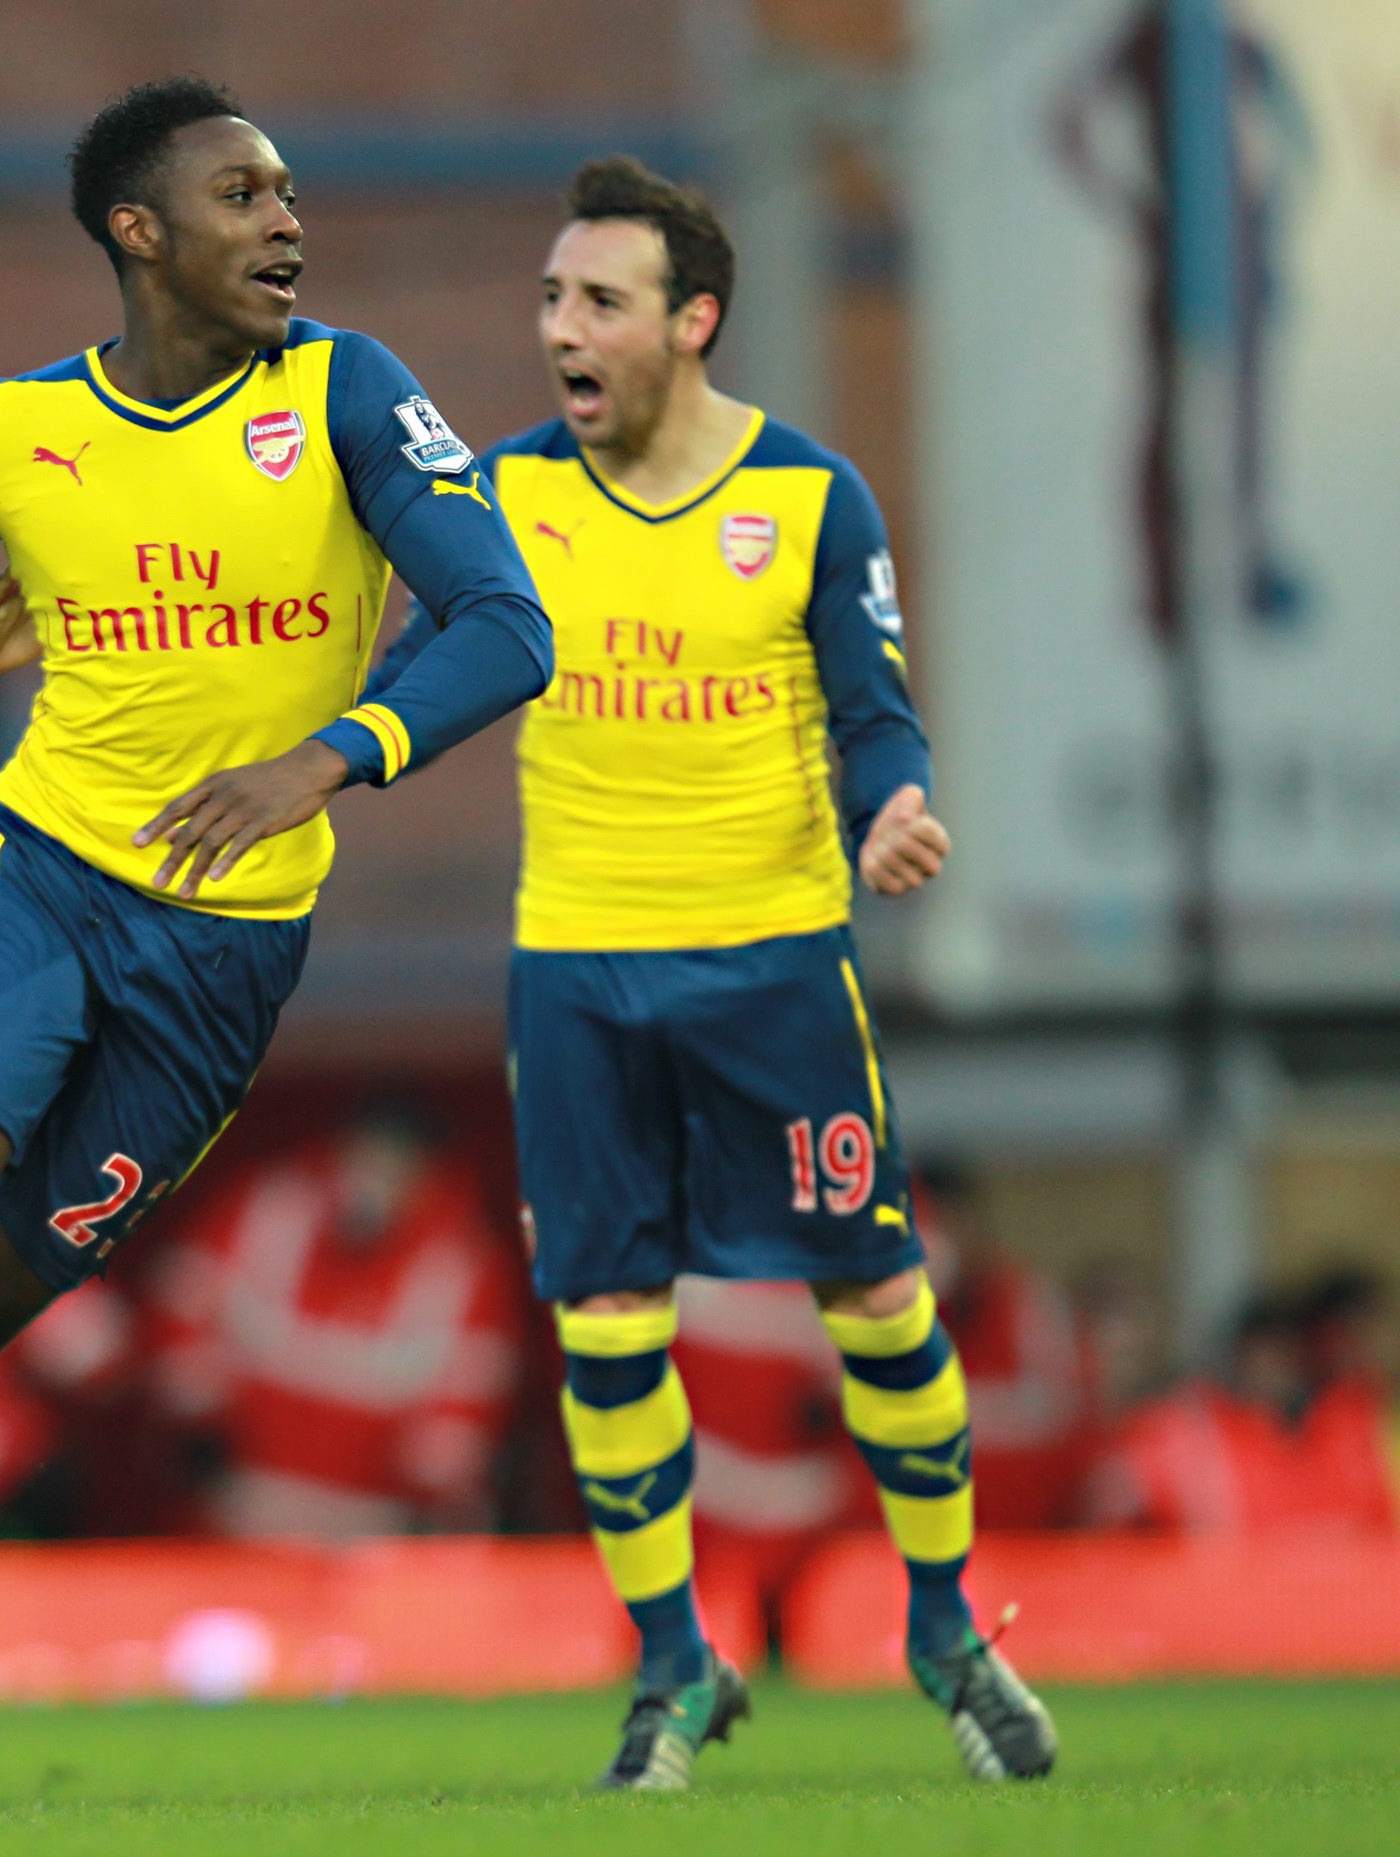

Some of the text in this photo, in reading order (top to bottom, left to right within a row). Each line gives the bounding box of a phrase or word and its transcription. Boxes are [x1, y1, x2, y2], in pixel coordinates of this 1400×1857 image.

[250, 418, 295, 437] Arsenal
[133, 542, 221, 591] Fly
[55, 590, 330, 652] Emirates
[605, 619, 684, 667] Fly
[786, 1111, 876, 1216] 19
[48, 1152, 171, 1260] 2
